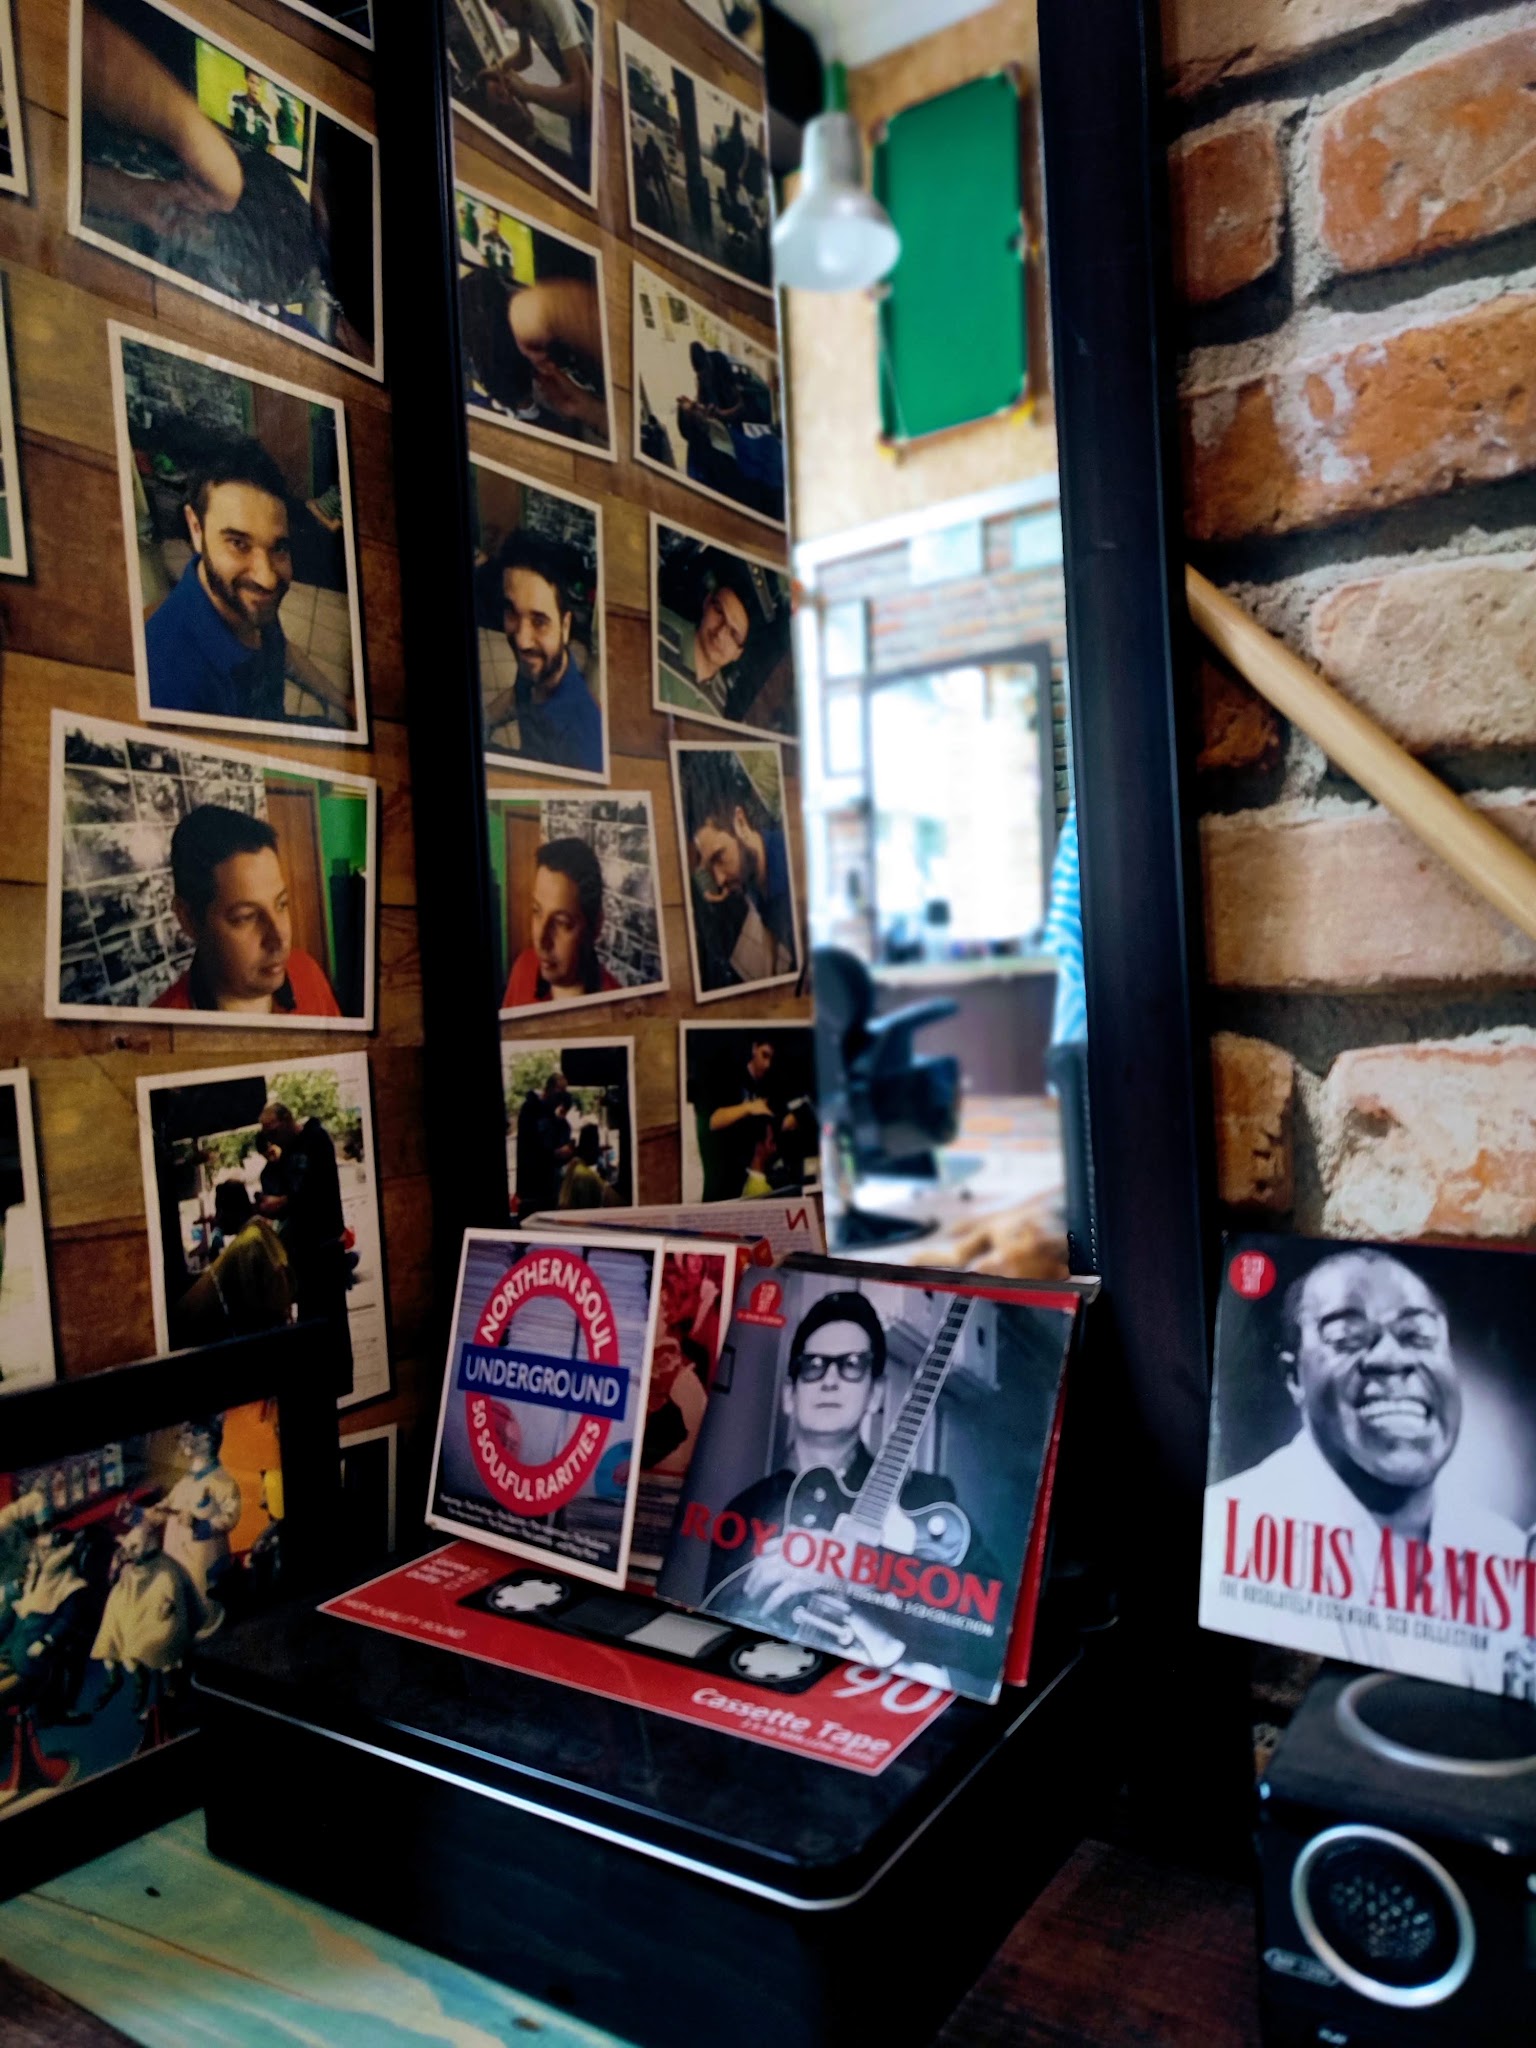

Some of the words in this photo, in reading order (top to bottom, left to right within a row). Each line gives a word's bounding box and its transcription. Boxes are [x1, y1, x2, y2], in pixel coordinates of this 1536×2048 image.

[480, 1257, 575, 1343] NORTHERN
[575, 1276, 613, 1360] SOUL
[465, 1354, 620, 1408] UNDERGROUND
[470, 1399, 484, 1430] 50
[476, 1430, 534, 1503] SOULFUL
[535, 1419, 601, 1501] RARITIES
[681, 1503, 778, 1557] ROY
[782, 1532, 1004, 1623] ORBISON
[1223, 1498, 1354, 1600] LOUIS
[691, 1687, 812, 1732] Cassette
[817, 1719, 892, 1754] Tape
[832, 1664, 943, 1714] 90
